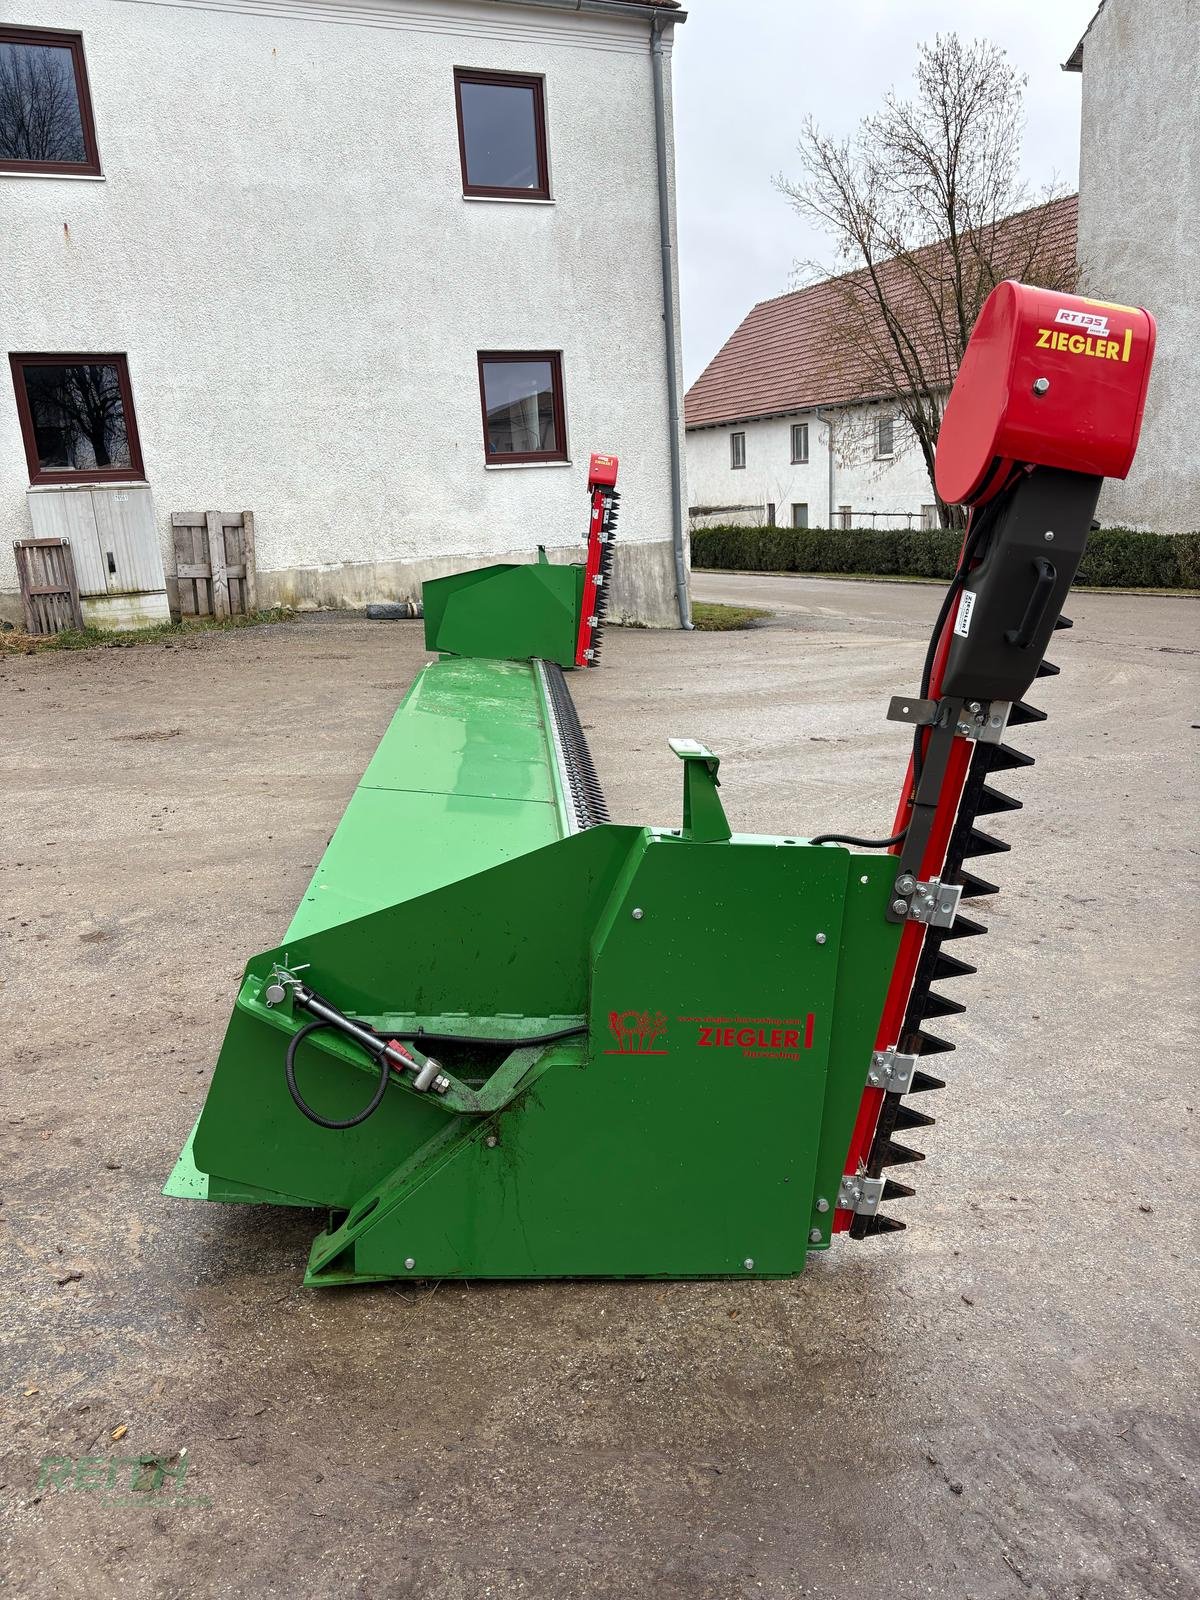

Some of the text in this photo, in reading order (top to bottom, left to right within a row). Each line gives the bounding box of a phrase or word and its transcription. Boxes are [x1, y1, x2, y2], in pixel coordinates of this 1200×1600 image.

[1060, 312, 1103, 327] RT 135
[1035, 328, 1119, 361] ZIEGLER
[696, 1027, 800, 1048] ZIEGLER
